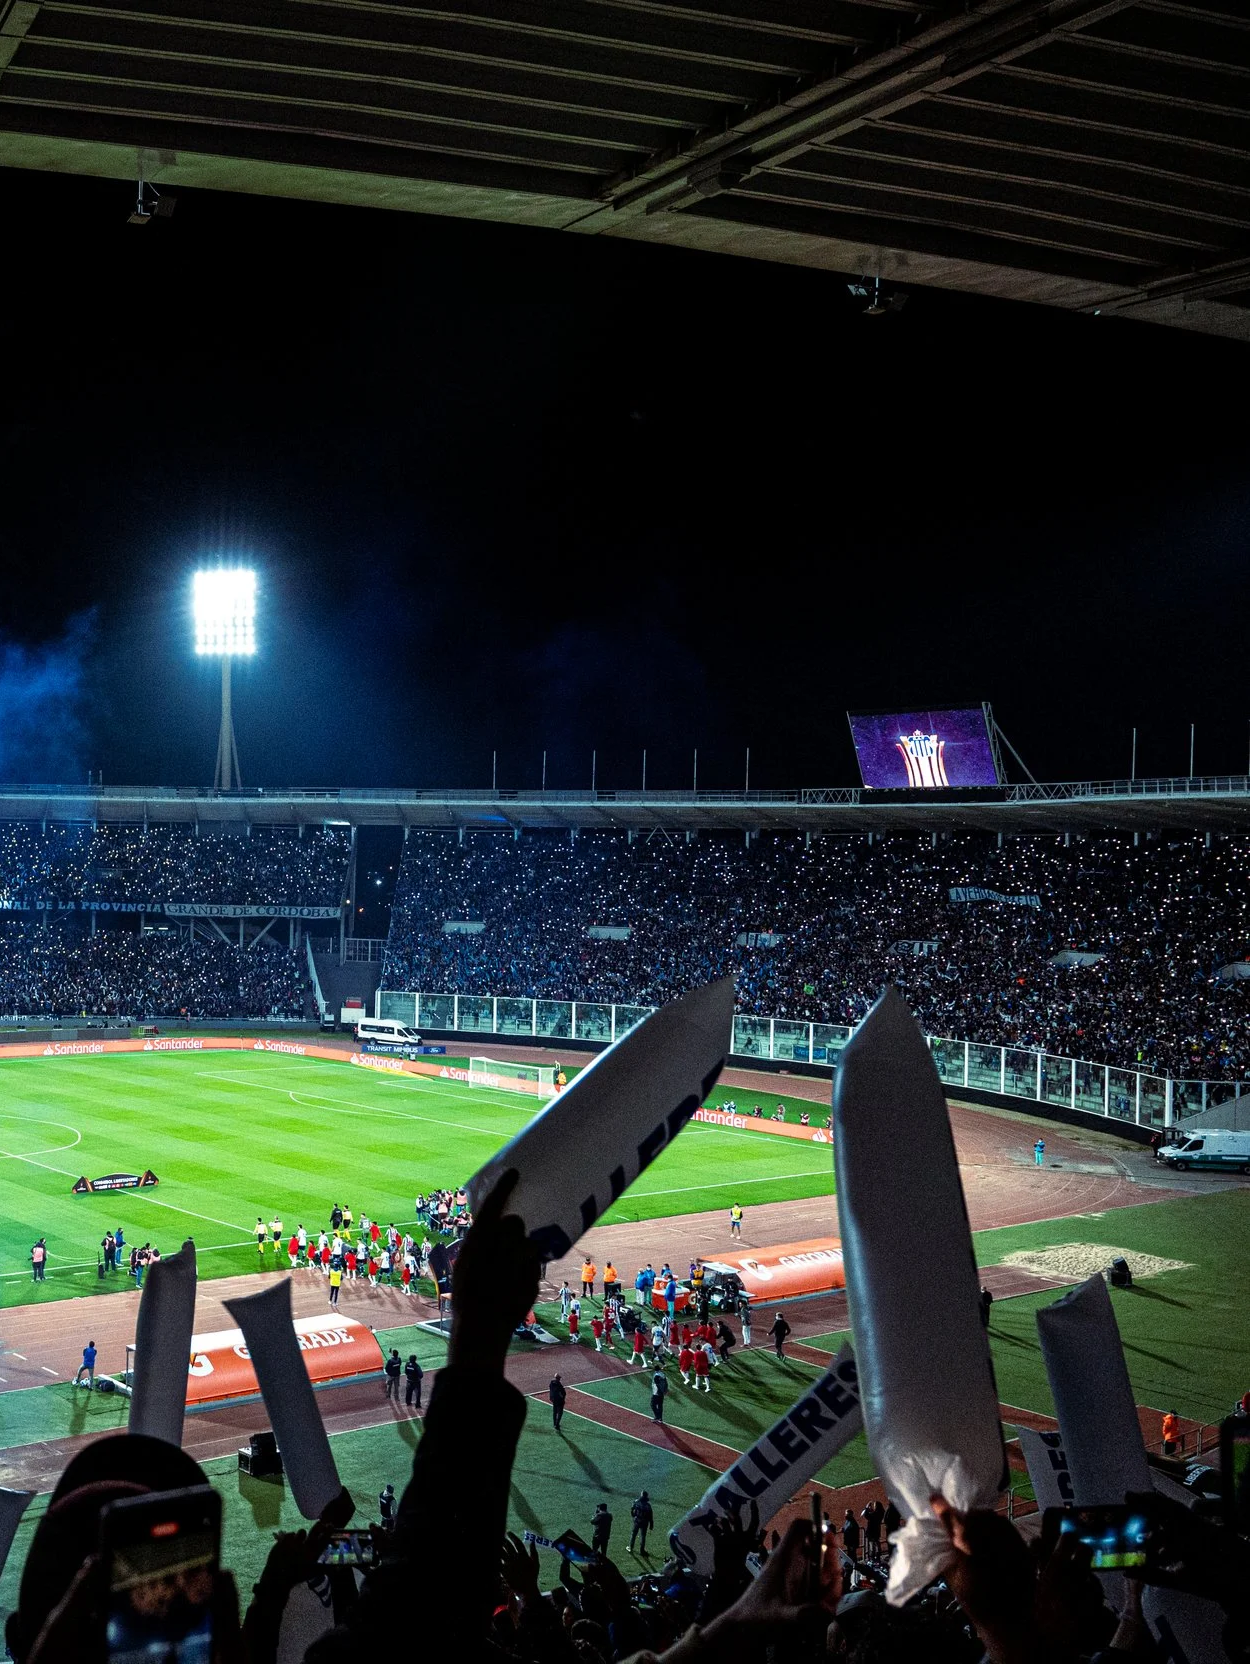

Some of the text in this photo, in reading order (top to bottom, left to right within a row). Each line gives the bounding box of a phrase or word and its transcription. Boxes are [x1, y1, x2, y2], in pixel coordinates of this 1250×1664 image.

[36, 901, 53, 910] DE
[58, 901, 76, 910] LA
[81, 901, 162, 913] PROVINCIA
[167, 904, 331, 917] GRANDE DE CORDOBA
[53, 1043, 104, 1055] Santander
[154, 1037, 203, 1050] Santander
[265, 1040, 306, 1055] Santander
[359, 1054, 404, 1071] Santander
[690, 1109, 748, 1129] antander
[233, 1328, 355, 1359] GRADE
